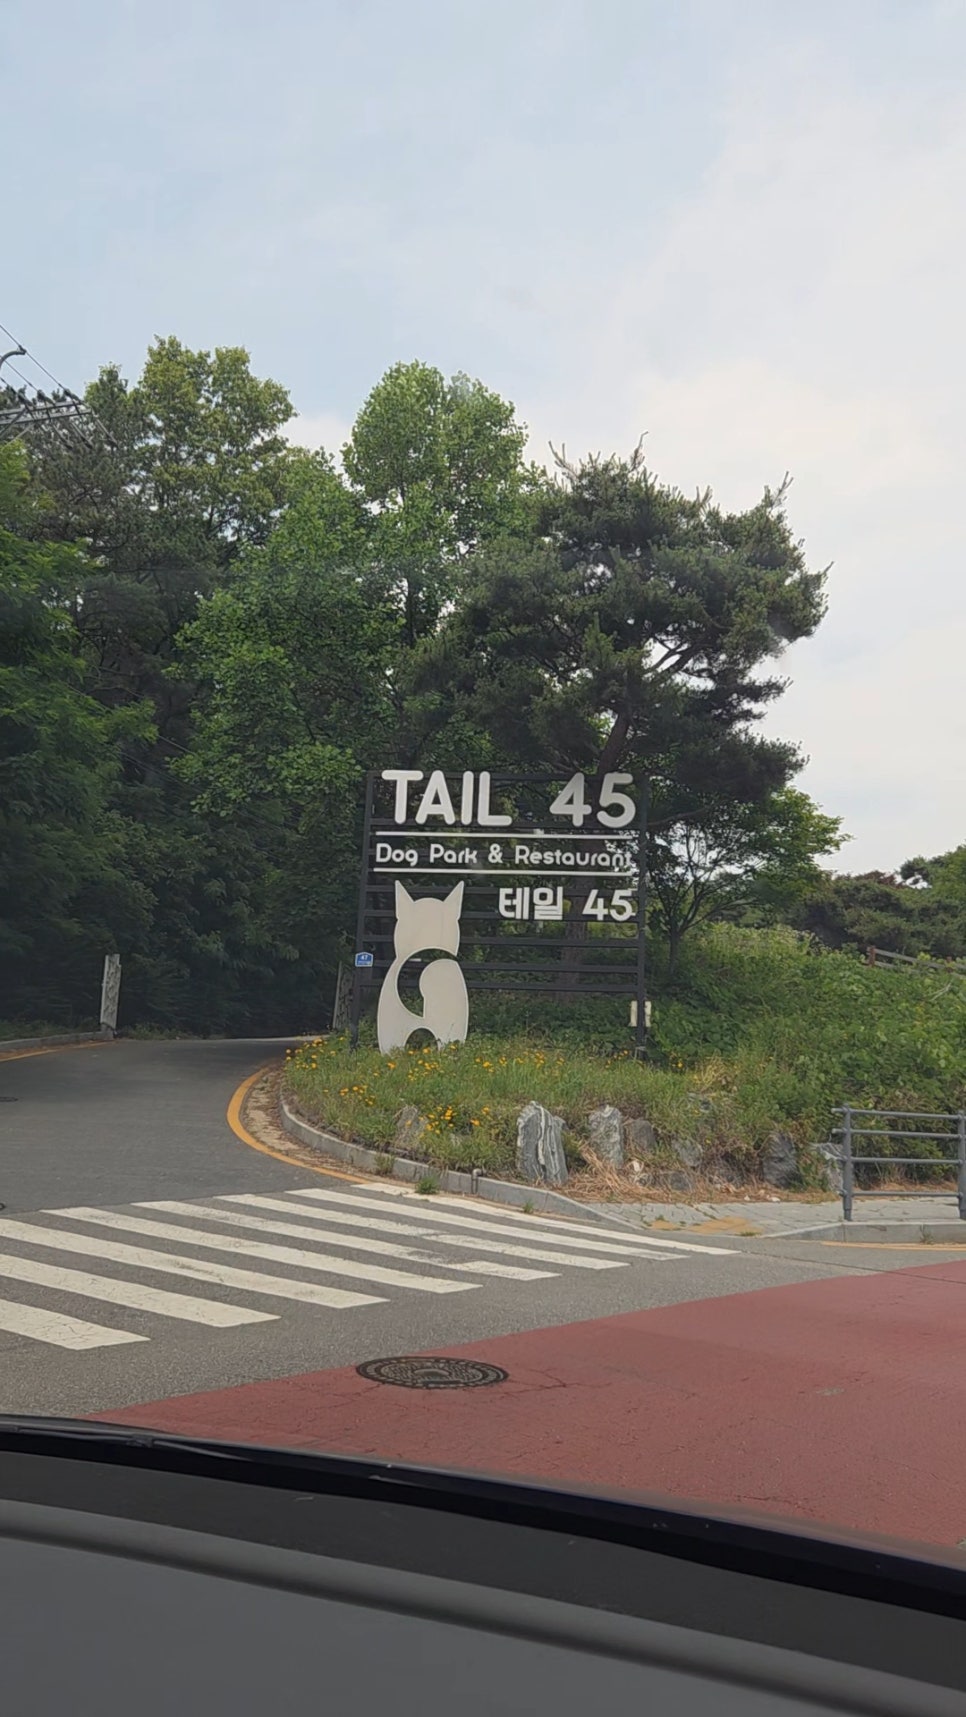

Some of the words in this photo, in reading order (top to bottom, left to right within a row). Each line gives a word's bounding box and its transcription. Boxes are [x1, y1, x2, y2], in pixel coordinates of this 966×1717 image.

[381, 769, 513, 826] TAIL
[549, 772, 636, 828] 45
[375, 843, 418, 867] Dog
[429, 844, 477, 865] Park
[488, 843, 503, 864] &
[515, 845, 632, 866] Restaurant
[498, 886, 563, 921] 테일
[582, 889, 634, 922] 45
